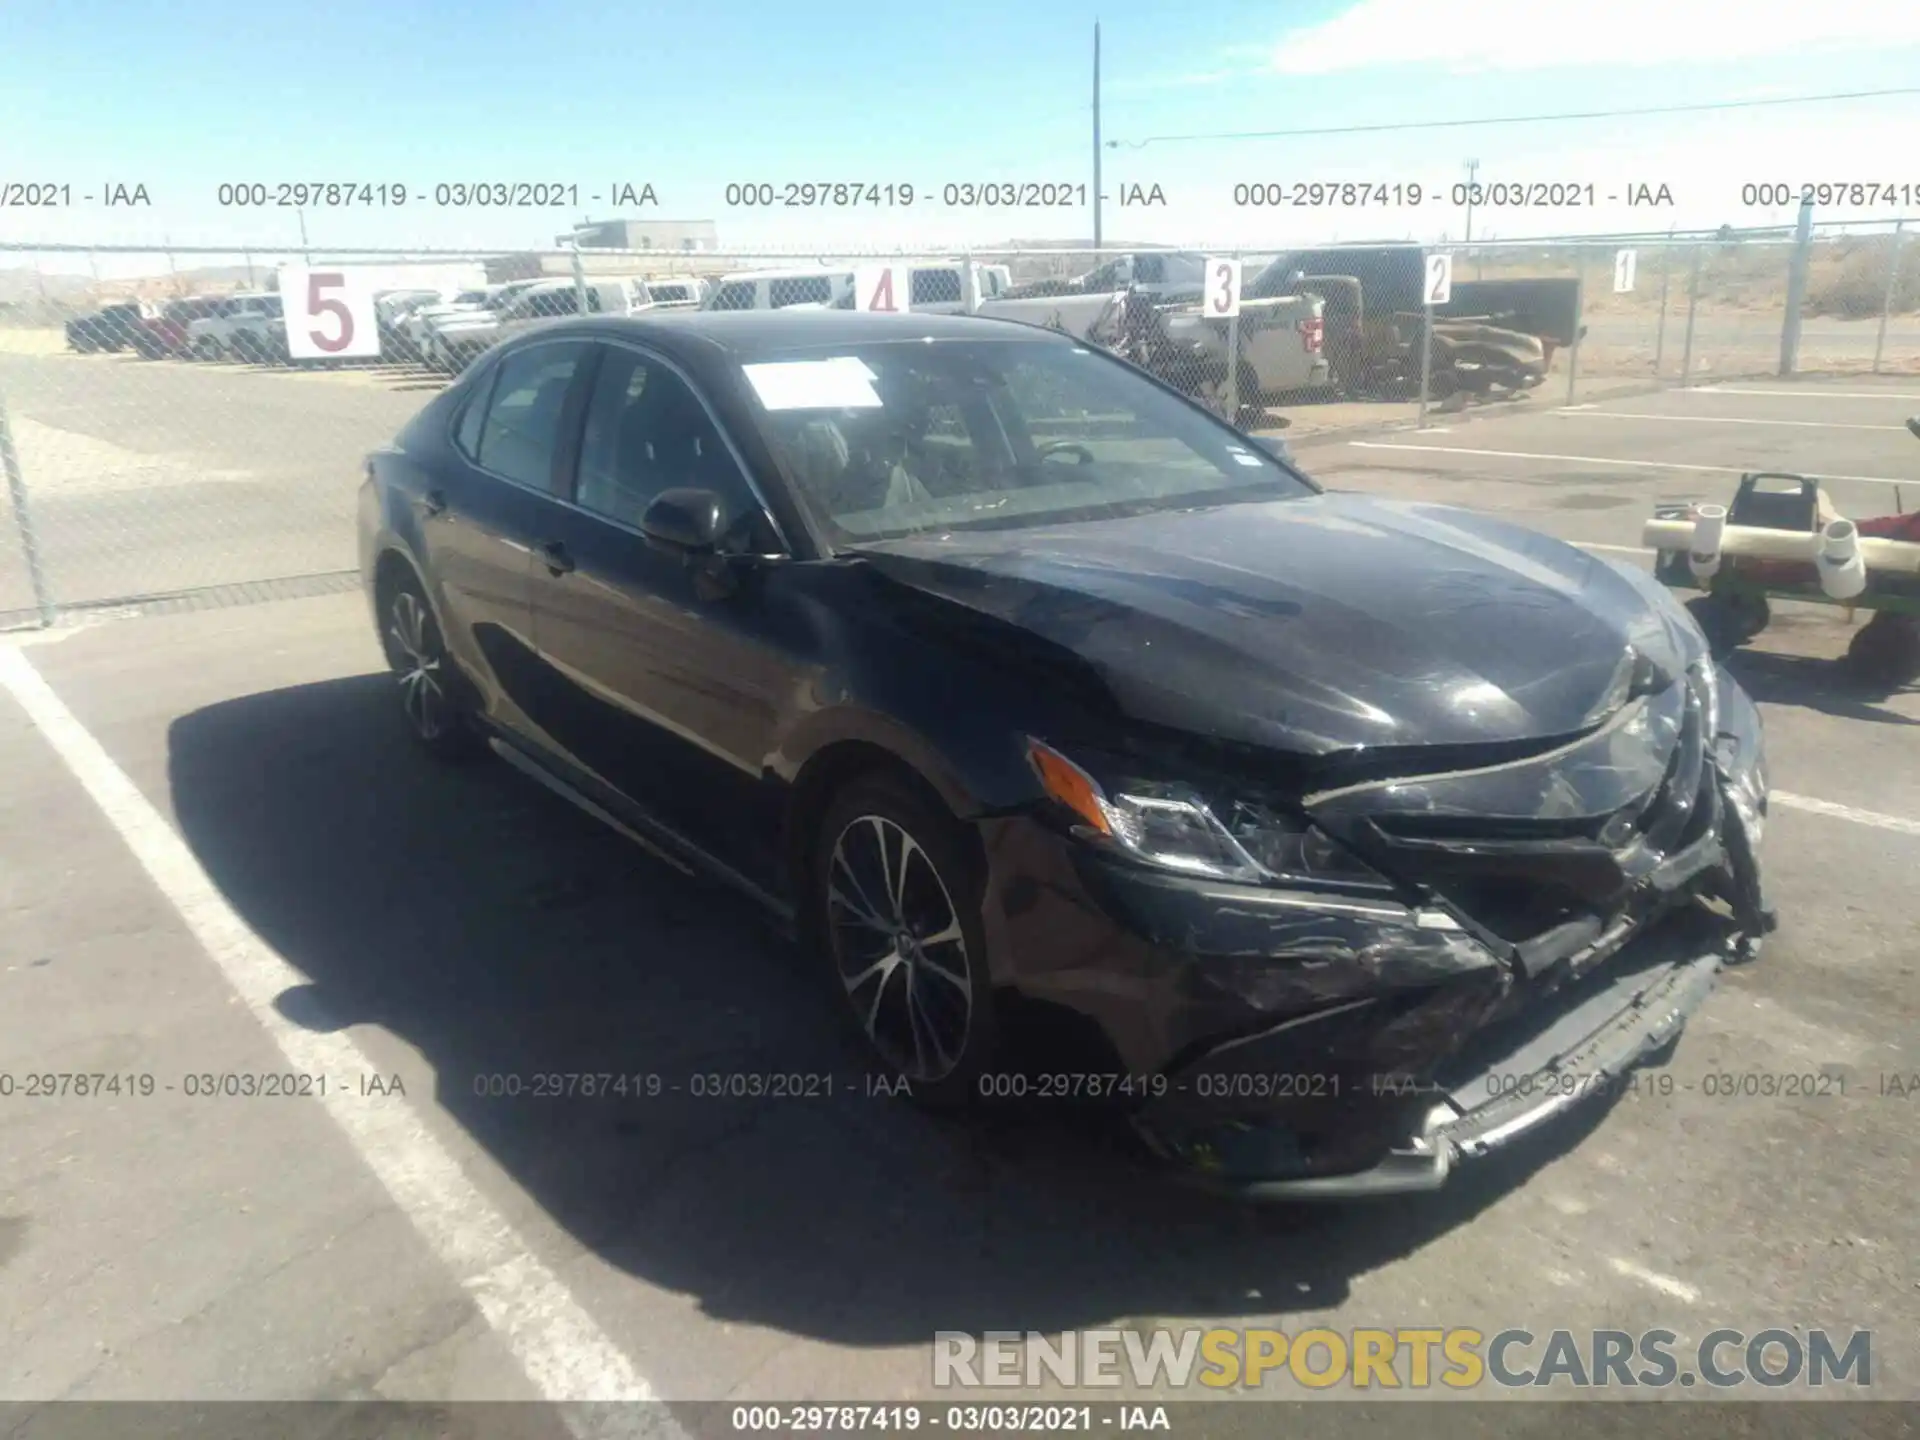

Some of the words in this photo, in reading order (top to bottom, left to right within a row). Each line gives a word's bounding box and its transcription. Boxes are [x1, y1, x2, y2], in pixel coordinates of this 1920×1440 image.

[868, 267, 899, 312] 4
[1214, 263, 1232, 313] 3
[1432, 257, 1446, 301] 2
[1620, 252, 1630, 289] 1
[307, 273, 354, 353] 5
